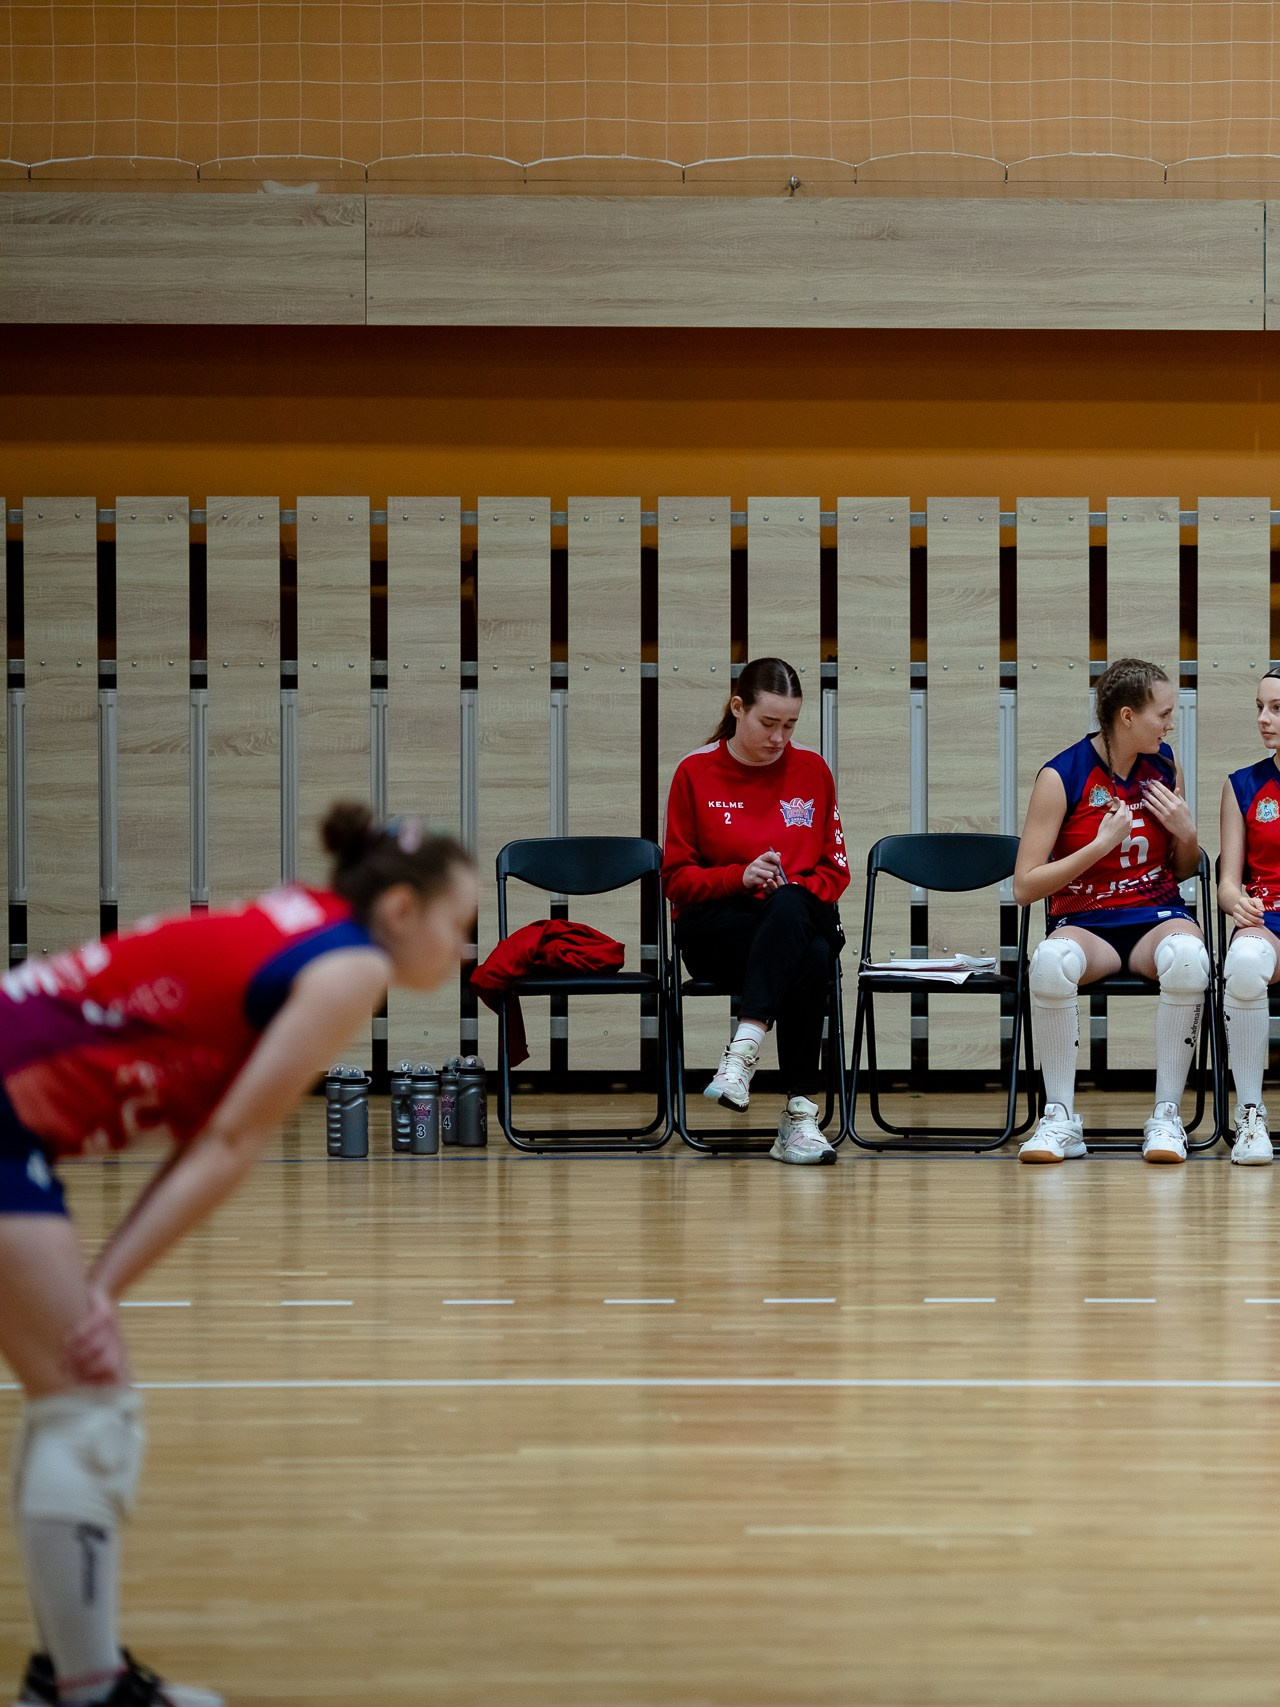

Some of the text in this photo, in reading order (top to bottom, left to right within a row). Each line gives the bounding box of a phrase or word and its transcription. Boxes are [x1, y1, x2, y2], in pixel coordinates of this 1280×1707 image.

[708, 800, 744, 809] KELME
[723, 812, 732, 825] 2
[1120, 818, 1149, 868] 5
[442, 1115, 452, 1130] 4
[416, 1123, 427, 1139] 3
